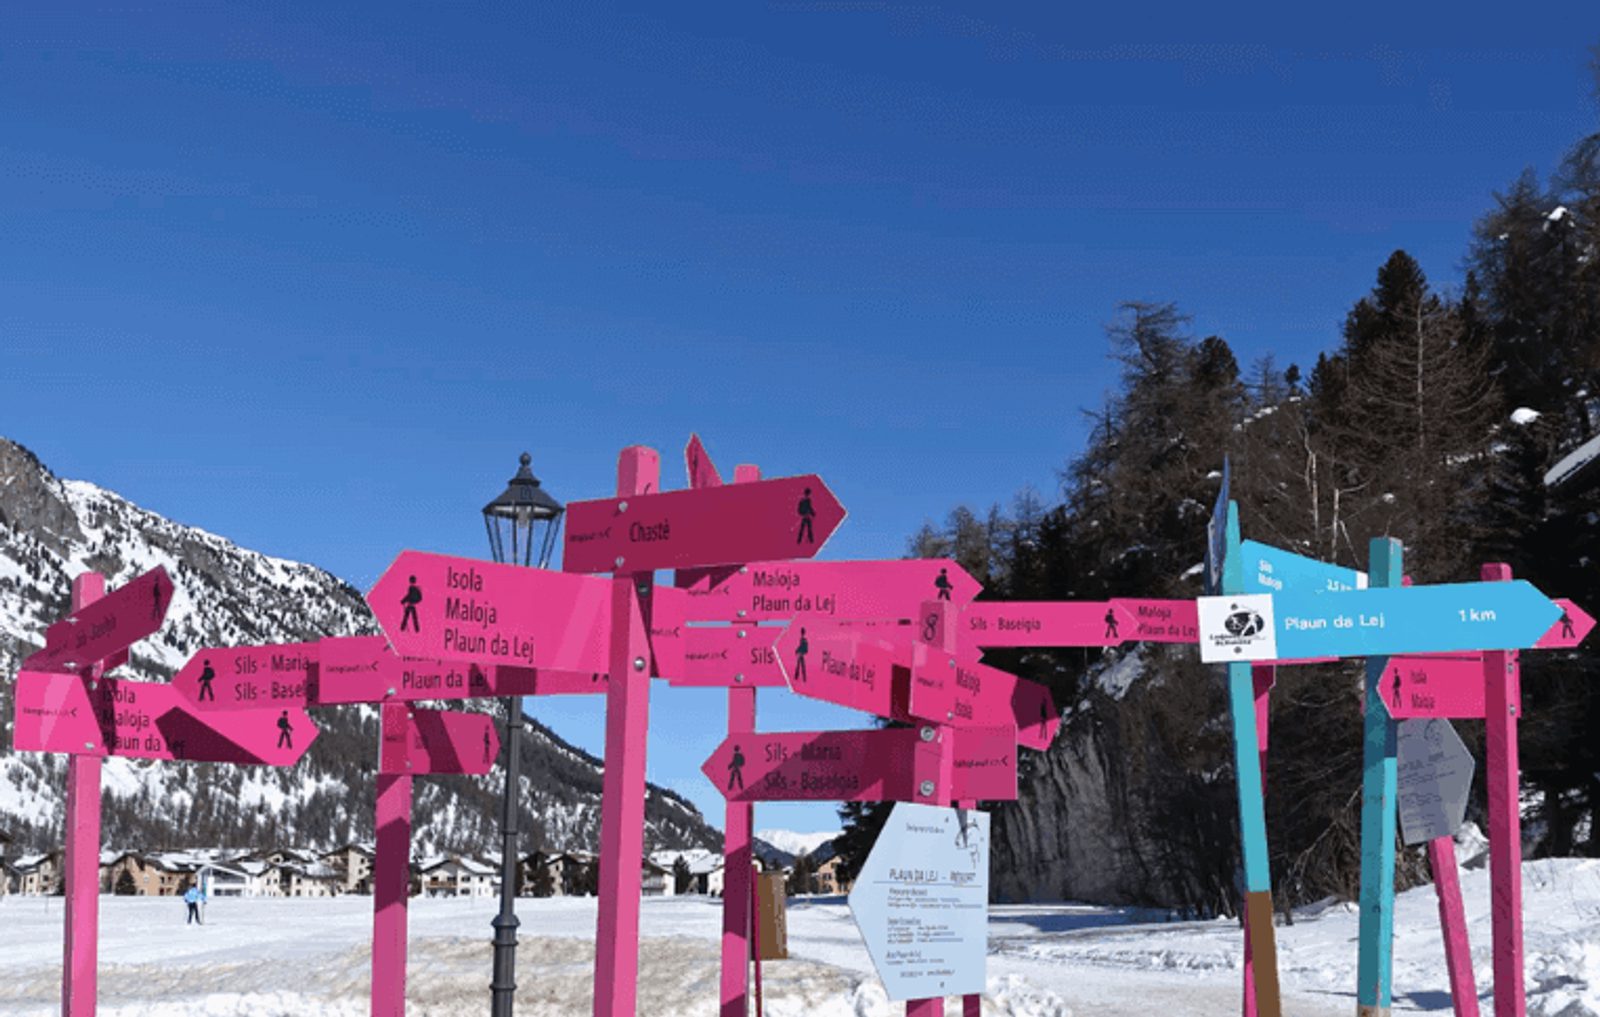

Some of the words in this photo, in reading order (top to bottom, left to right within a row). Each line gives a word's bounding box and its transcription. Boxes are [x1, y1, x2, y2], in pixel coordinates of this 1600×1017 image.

[446, 566, 483, 592] Isola
[753, 569, 800, 591] Maloja
[445, 597, 497, 630] Maloja
[753, 594, 790, 611] Plaun
[794, 593, 811, 611] da
[815, 593, 836, 615] Lej
[1458, 609, 1467, 622] 1
[1469, 608, 1497, 622] km
[970, 616, 988, 631] Sils
[1285, 615, 1327, 630] Plaun
[1333, 614, 1353, 629] da
[1359, 612, 1385, 628] Lej
[443, 627, 486, 654] Plaun
[490, 632, 510, 655] da
[513, 635, 535, 665] Lej
[751, 646, 775, 664] Sils
[234, 654, 258, 675] Sils
[271, 652, 310, 672] Maria
[402, 670, 442, 691] Plaun
[446, 669, 463, 689] da
[469, 668, 488, 690] Lej
[234, 681, 258, 702] Sils
[102, 707, 150, 732] Maloja
[102, 733, 139, 750] Plaun
[144, 734, 161, 752] da
[764, 742, 788, 763] Sils
[763, 769, 788, 791] Sils
